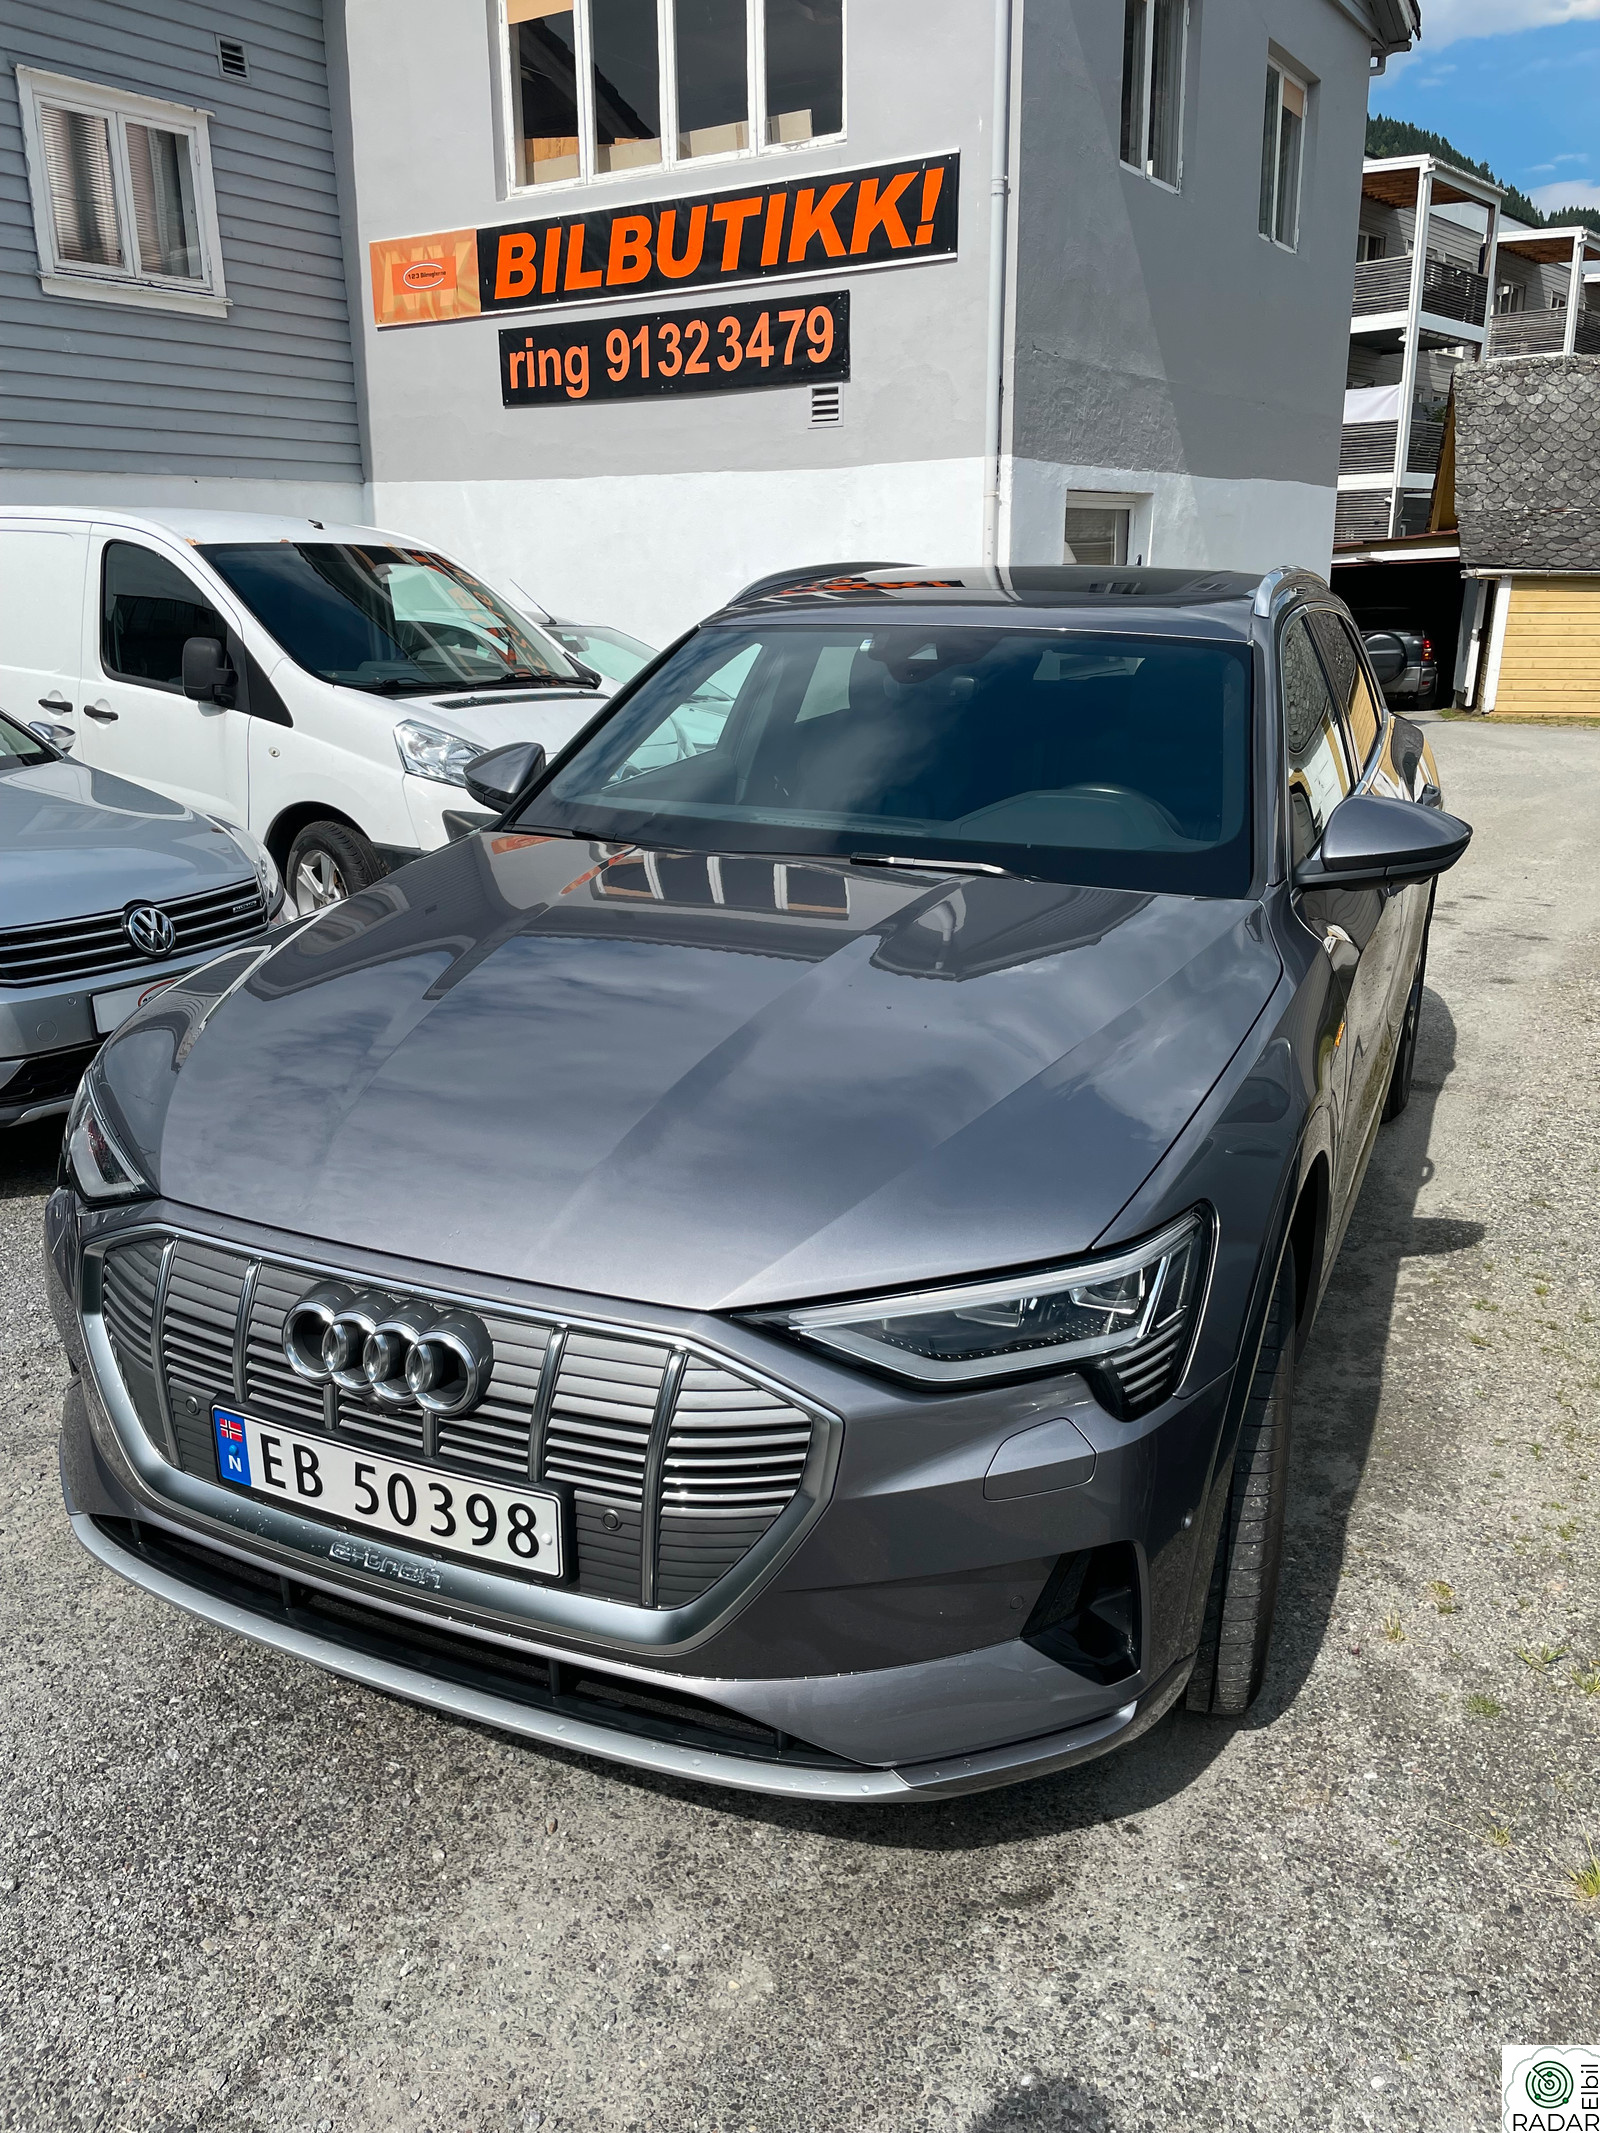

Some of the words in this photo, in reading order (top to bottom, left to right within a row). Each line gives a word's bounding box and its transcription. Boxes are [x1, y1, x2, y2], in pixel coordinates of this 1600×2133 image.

[494, 166, 945, 300] BILBUTIKK!
[509, 337, 590, 399] ring
[605, 305, 834, 382] 91323479
[228, 1454, 243, 1474] N
[260, 1432, 323, 1498] EB
[354, 1461, 541, 1559] 50398
